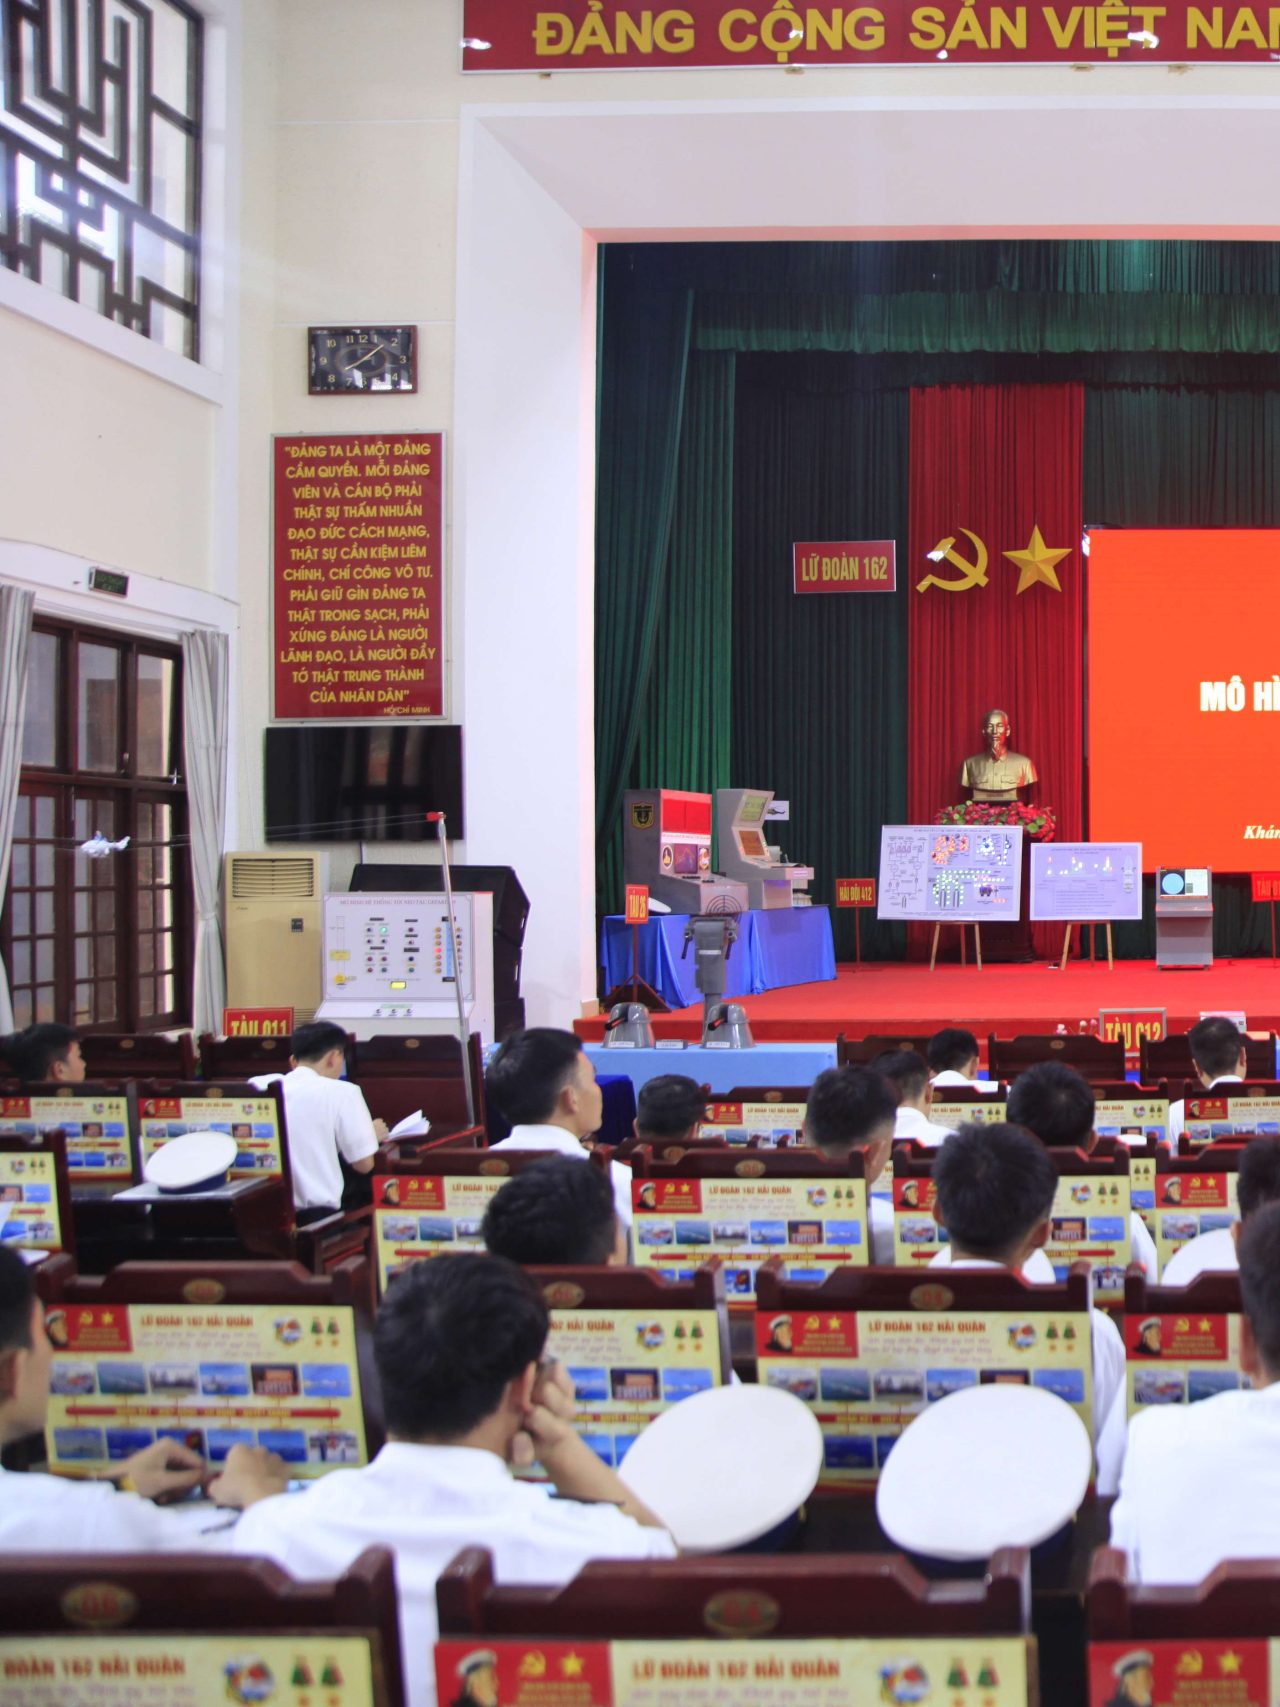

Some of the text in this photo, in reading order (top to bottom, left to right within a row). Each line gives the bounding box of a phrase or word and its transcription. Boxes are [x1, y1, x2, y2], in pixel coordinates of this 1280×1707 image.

[533, 0, 694, 54] ĐẢNG
[720, 0, 884, 62] CỘNG
[911, 0, 1026, 49] SẢN
[1044, 0, 1166, 57] VIỆT
[330, 446, 343, 456] TA
[347, 441, 361, 456] LÀ
[364, 441, 391, 459] MỘT
[394, 440, 431, 455] ĐẢNG
[286, 459, 430, 478] CẦM QUYỀN. MỖI ĐẢNG
[293, 481, 421, 499] VIÊN VÀ CÁN BỘ PHẢI
[288, 523, 430, 542] ĐẠO ĐỨC CÁCH MẠNG,
[291, 542, 426, 563] THẬT SỰ CẦN KIỆM LIÊM
[283, 564, 432, 582] CHÍNH, CHÍ CÔNG VÔ TƯ.
[802, 553, 888, 581] LỮ ĐOÀN 162
[290, 584, 425, 601] PHẢI GIỮ GÌN ĐẢNG TA
[288, 604, 429, 624] THẬT TRONG SẠCH, PHẢI
[290, 625, 427, 642] XỨNG ĐÁNG LÀ NGƯỜI
[310, 687, 336, 703] CỦA
[340, 688, 374, 702] NHÂN
[1201, 676, 1245, 711] MÔ
[862, 886, 872, 900] 412
[231, 1014, 286, 1036] TÀU 011
[1106, 1016, 1132, 1050] TÀU
[720, 1184, 740, 1194] ĐOÀN
[743, 1186, 755, 1194] 162
[772, 1184, 792, 1194] QUÂN
[884, 1320, 912, 1332] ĐOÀN
[916, 1320, 934, 1332] 162
[937, 1318, 954, 1332] HẢI
[958, 1319, 986, 1333] QUÂN
